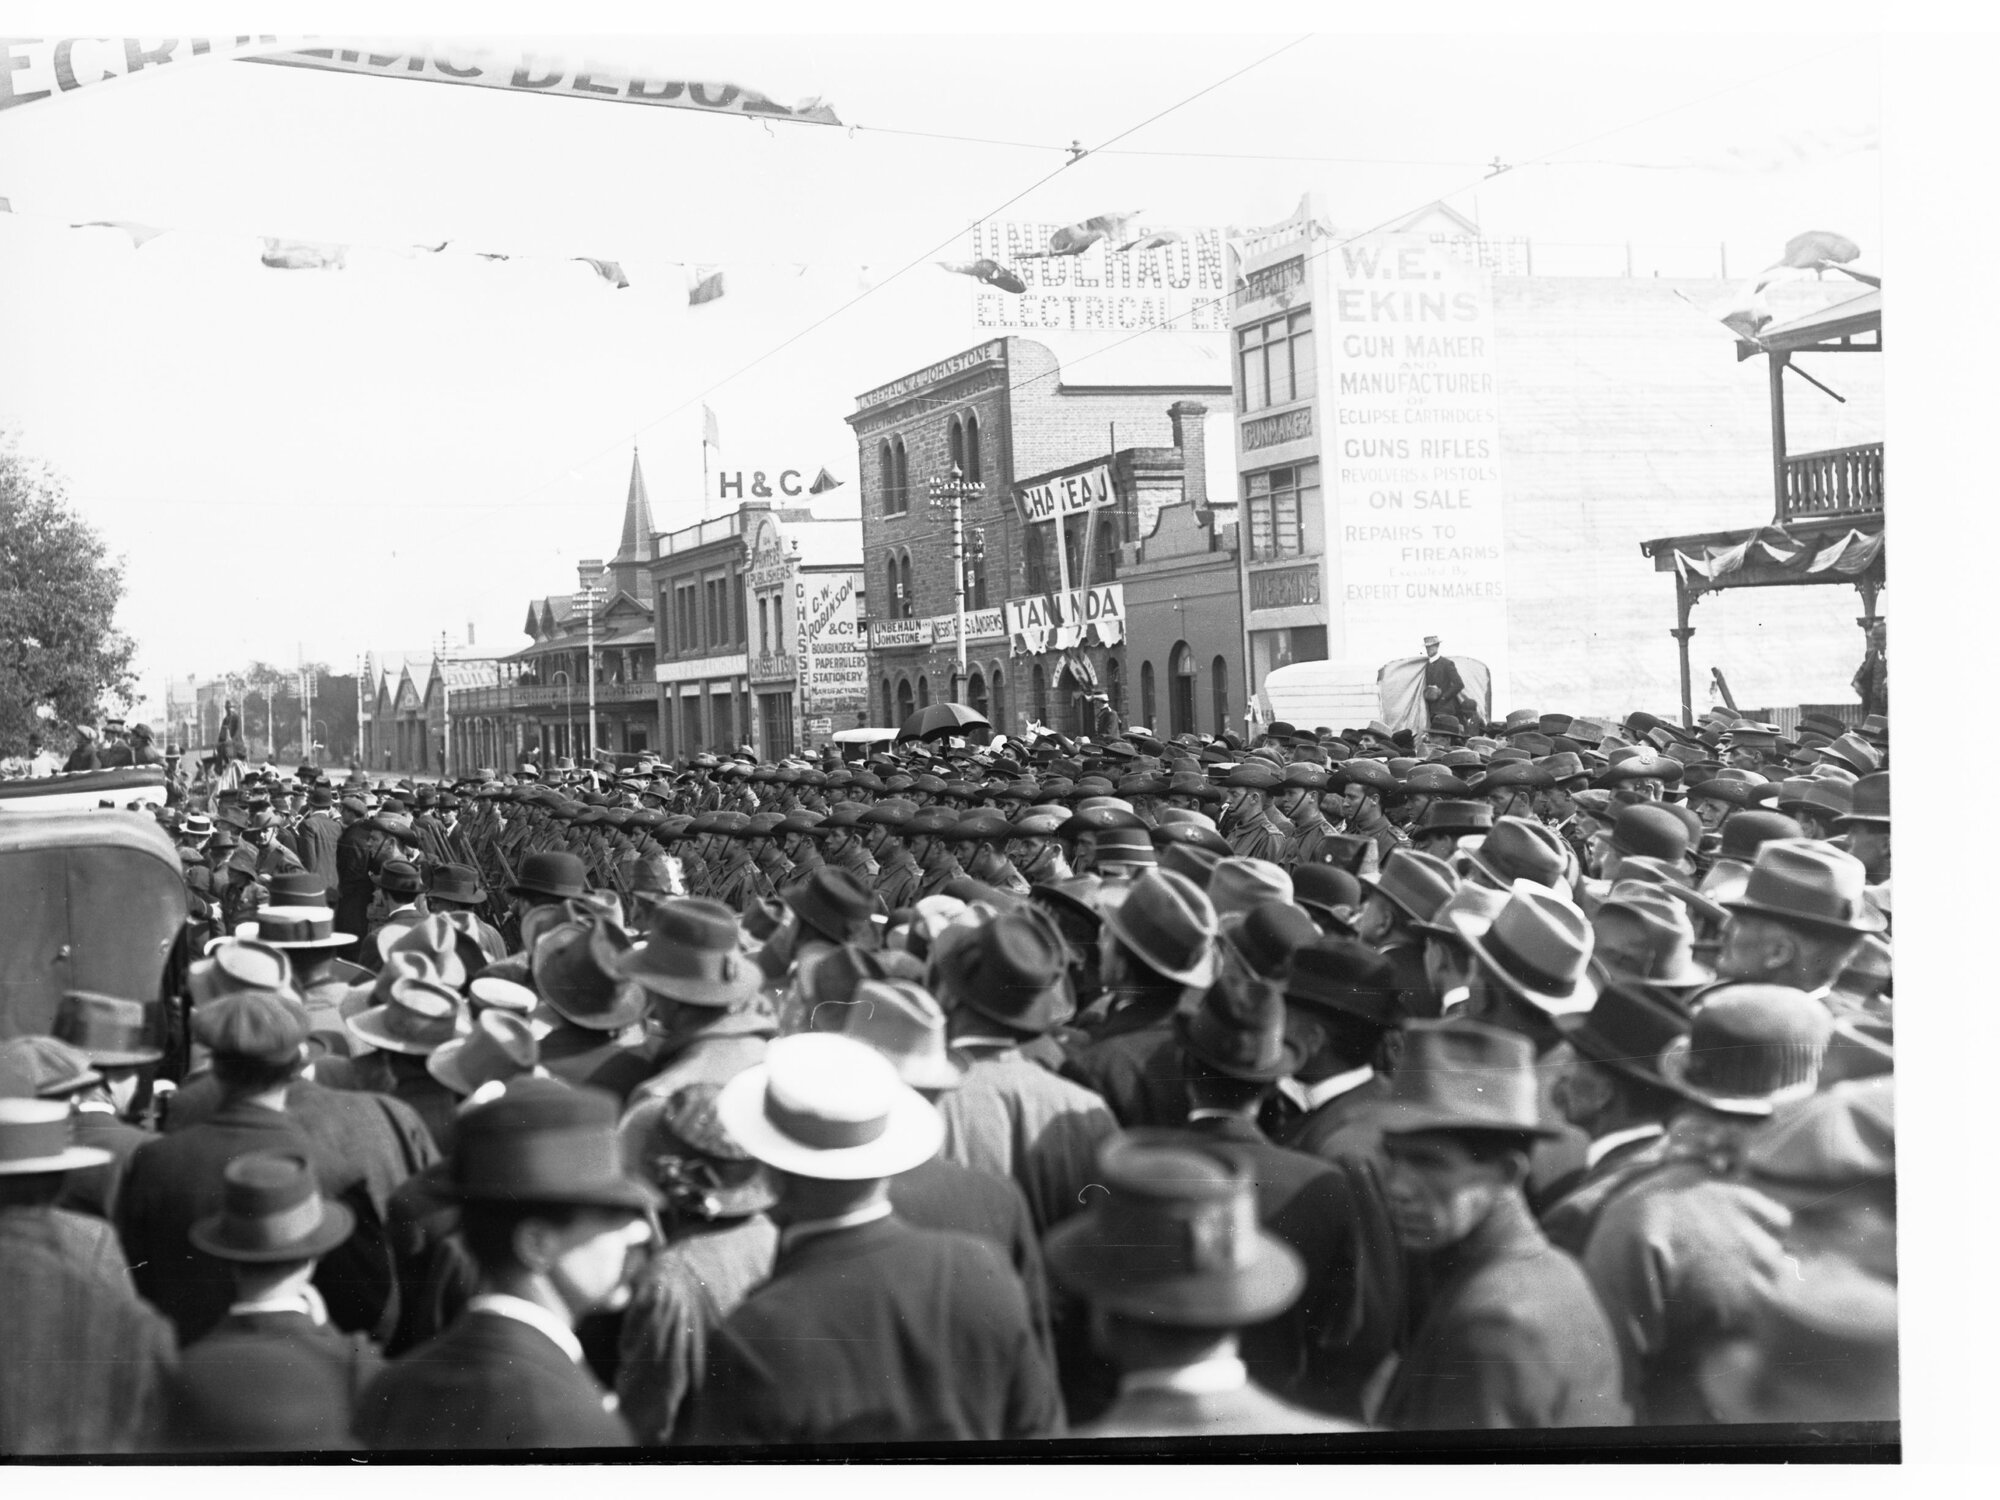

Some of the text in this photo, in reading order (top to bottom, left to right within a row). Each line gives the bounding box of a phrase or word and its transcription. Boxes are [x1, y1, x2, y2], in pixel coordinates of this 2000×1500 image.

[1340, 246, 1442, 280] W.E.
[977, 293, 1178, 329] ELECTRICAL
[1337, 288, 1479, 323] EKINS
[1343, 333, 1486, 358] GUN MAKER
[923, 345, 992, 386] JOHNSTONE
[1399, 361, 1438, 371] AND
[1340, 372, 1493, 396] MANUFACTURER
[1339, 407, 1495, 425] ECLIPSE CARTRIDGES
[1243, 411, 1312, 452] GUNMAKER
[1345, 438, 1490, 459] GUNS RIFLES
[1341, 468, 1418, 484] REVOLVERS
[1433, 467, 1498, 482] PISTOLS
[1369, 488, 1473, 510] ON SALE
[1345, 524, 1457, 542] REPAIRS TO
[1401, 545, 1500, 562] FIREARMS
[1346, 581, 1504, 601] EXPERT GUNMAKERS
[808, 575, 853, 643] ROBINSON
[875, 620, 922, 635] UNBEHAUN
[875, 632, 921, 646] JOHNSTONE
[812, 671, 864, 684] STATIONERY
